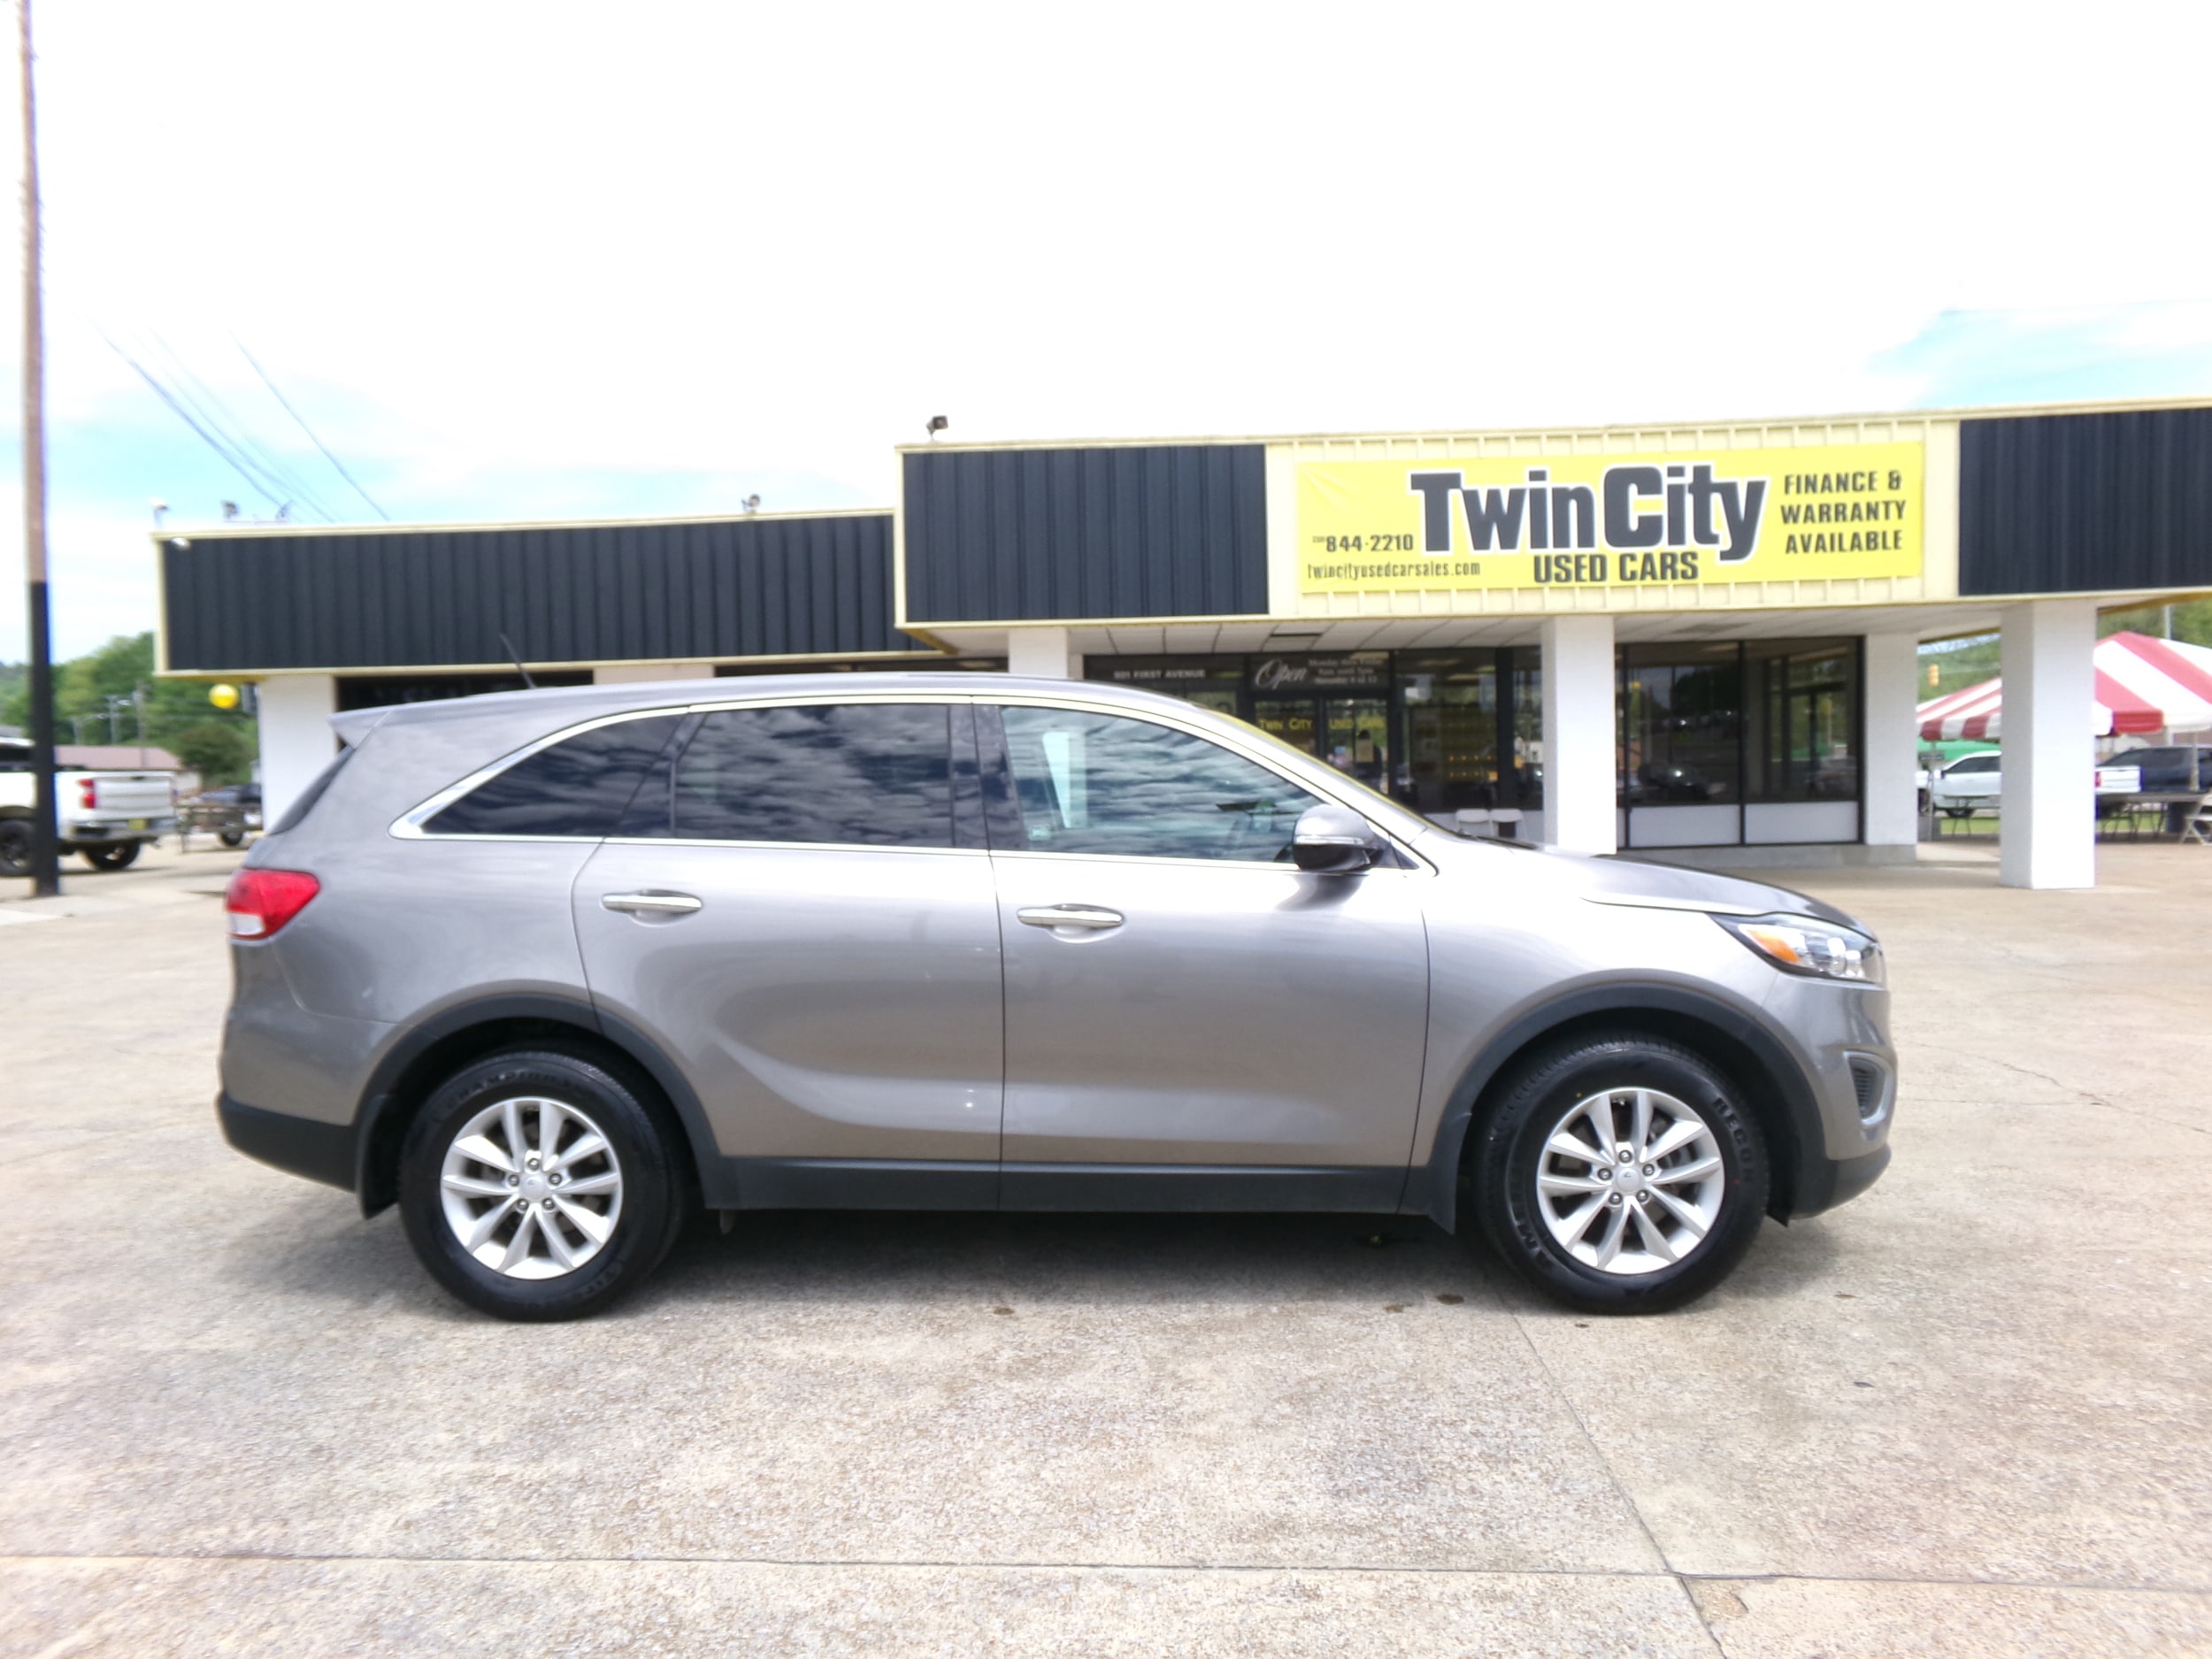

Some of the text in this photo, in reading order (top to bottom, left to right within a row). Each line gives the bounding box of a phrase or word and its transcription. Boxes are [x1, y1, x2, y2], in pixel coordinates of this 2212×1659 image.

[1784, 470, 1901, 495] FINANCE &
[1780, 500, 1906, 524] WARRANTY
[1786, 530, 1902, 554] AVAILABLE
[1533, 551, 1699, 583] USED CARS
[1255, 659, 1307, 690] Open
